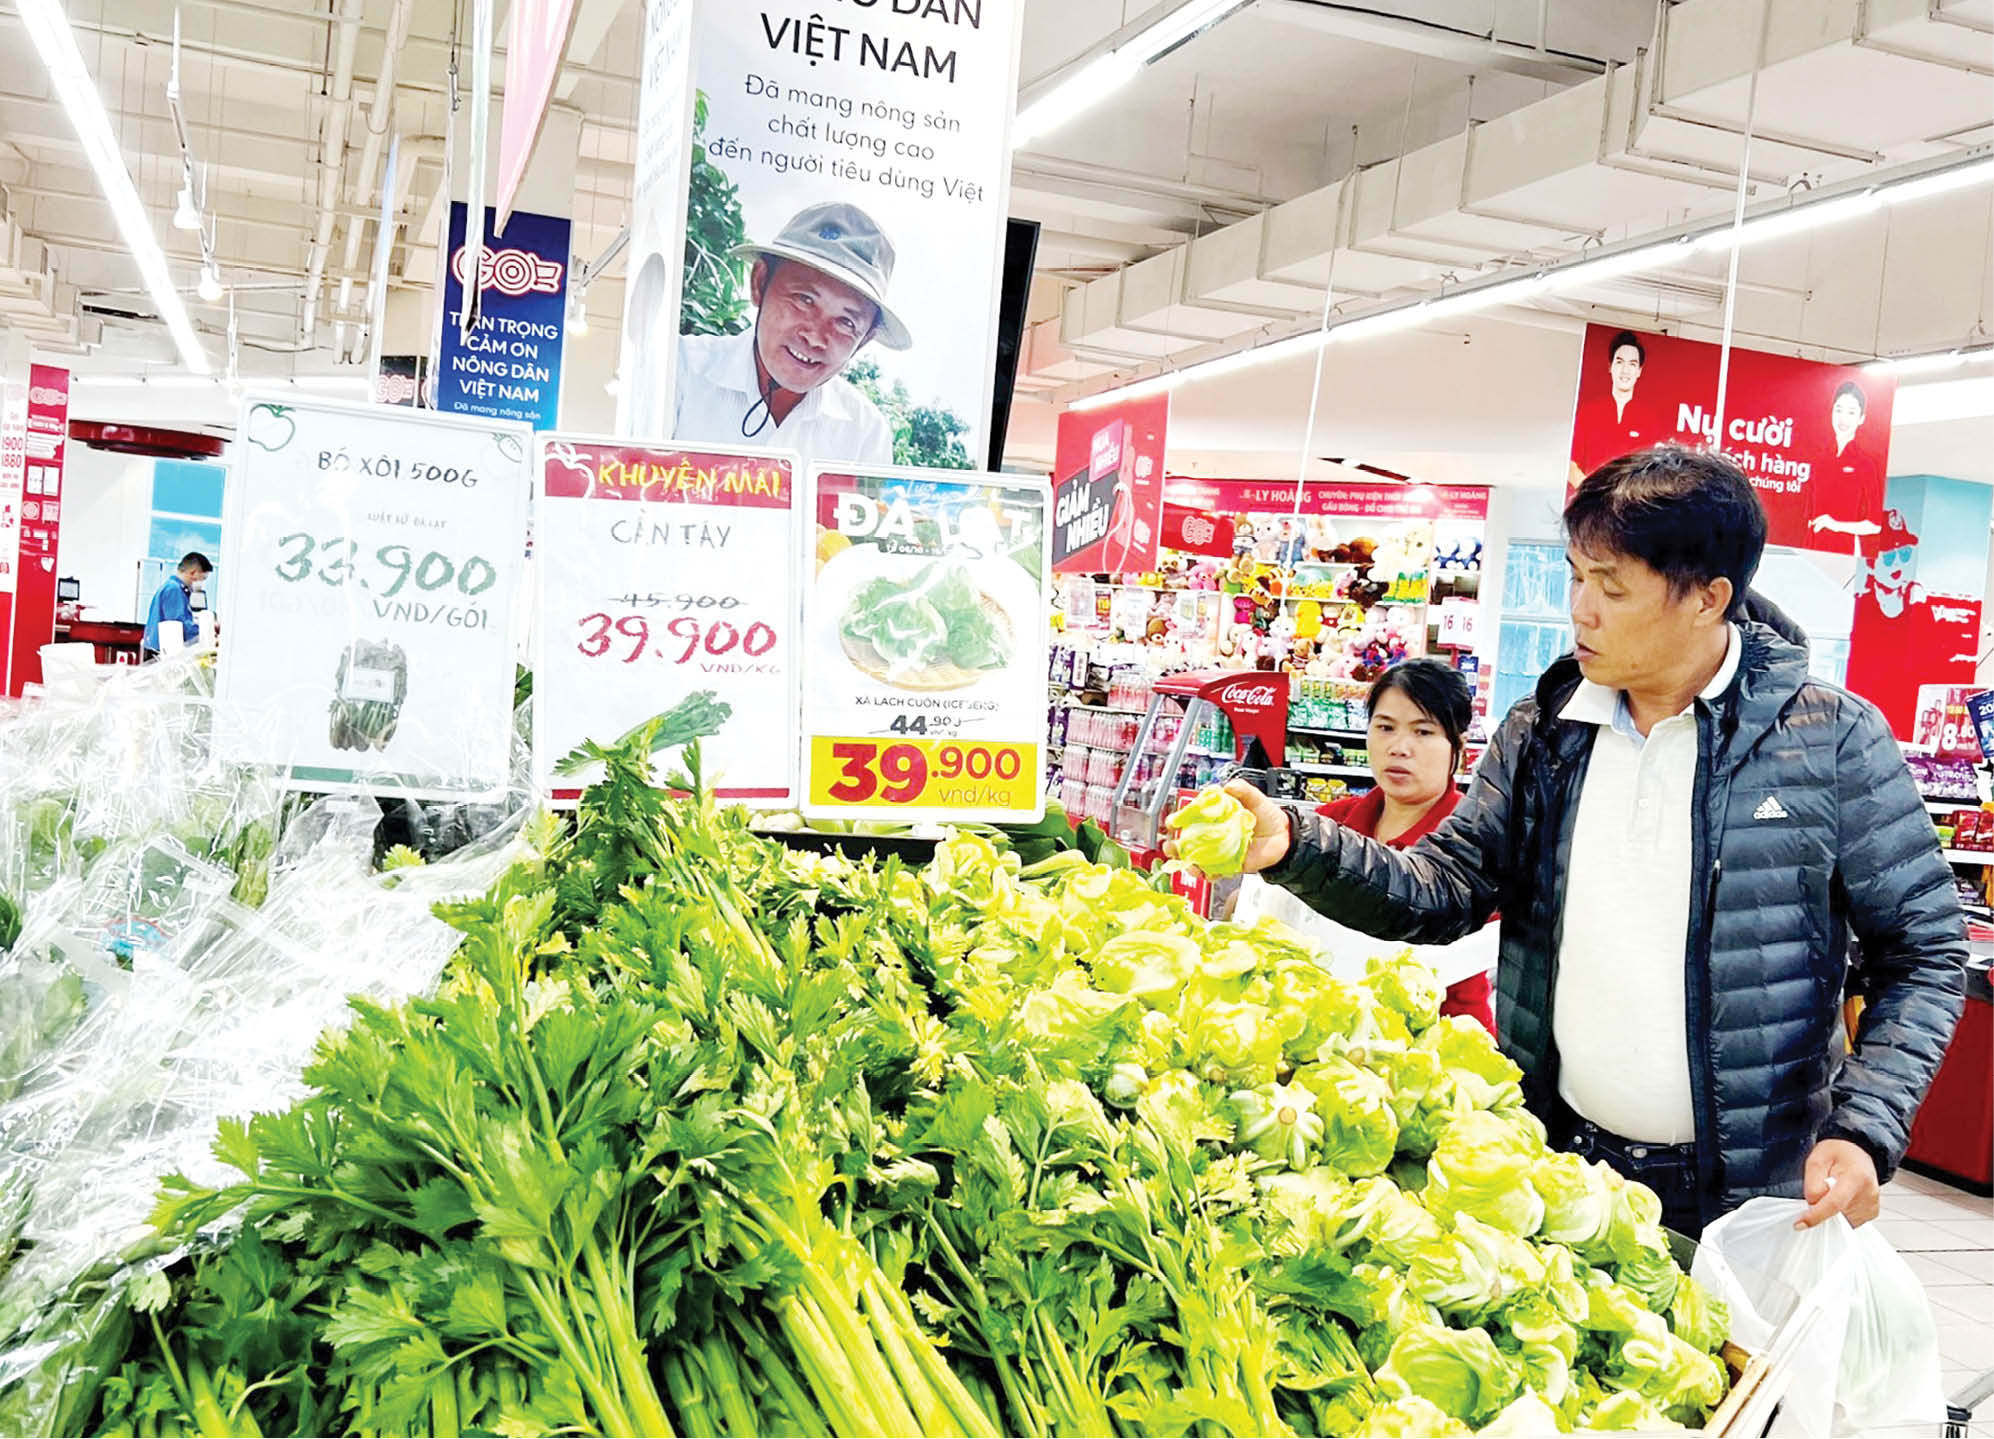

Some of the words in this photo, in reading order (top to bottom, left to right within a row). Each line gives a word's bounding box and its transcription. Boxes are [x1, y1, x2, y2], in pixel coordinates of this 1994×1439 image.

[760, 12, 850, 66] VIỆT
[860, 33, 957, 83] NAM
[745, 73, 779, 100] Đã
[788, 88, 853, 118] mang
[861, 100, 915, 129] nông
[923, 110, 960, 132] sản
[768, 114, 817, 140] chất
[825, 121, 886, 157] lượng
[894, 141, 935, 160] cao
[708, 136, 752, 161] đến
[761, 150, 823, 173] người
[831, 158, 871, 182] tiêu
[878, 166, 934, 199] dùng
[943, 176, 983, 204] Việt
[497, 317, 558, 340] TRỌNG
[467, 335, 507, 355] CẢM
[510, 342, 539, 360] ƠN
[452, 355, 507, 377] NÔNG
[511, 362, 549, 382] DÂN
[459, 377, 496, 399] VIỆT
[498, 384, 540, 403] NAM
[454, 401, 468, 411] Đã
[471, 405, 498, 417] mang
[499, 406, 522, 419] nông
[1728, 415, 1793, 448] cười
[410, 462, 478, 488] 500G
[1761, 452, 1811, 482] hàng
[1750, 475, 1784, 493] chúng
[1785, 479, 1801, 493] tôi
[1055, 479, 1091, 528] GIẢM
[1066, 496, 1110, 553] NHIỀU
[275, 532, 497, 597] 33.900
[372, 599, 488, 631] VND/GÓI
[621, 593, 741, 611] 45.900
[577, 612, 777, 664] 39.900
[1443, 615, 1454, 630] 16
[1462, 616, 1473, 632] 16
[827, 743, 1021, 804] 39.900
[938, 786, 1012, 806] vnd/kg
